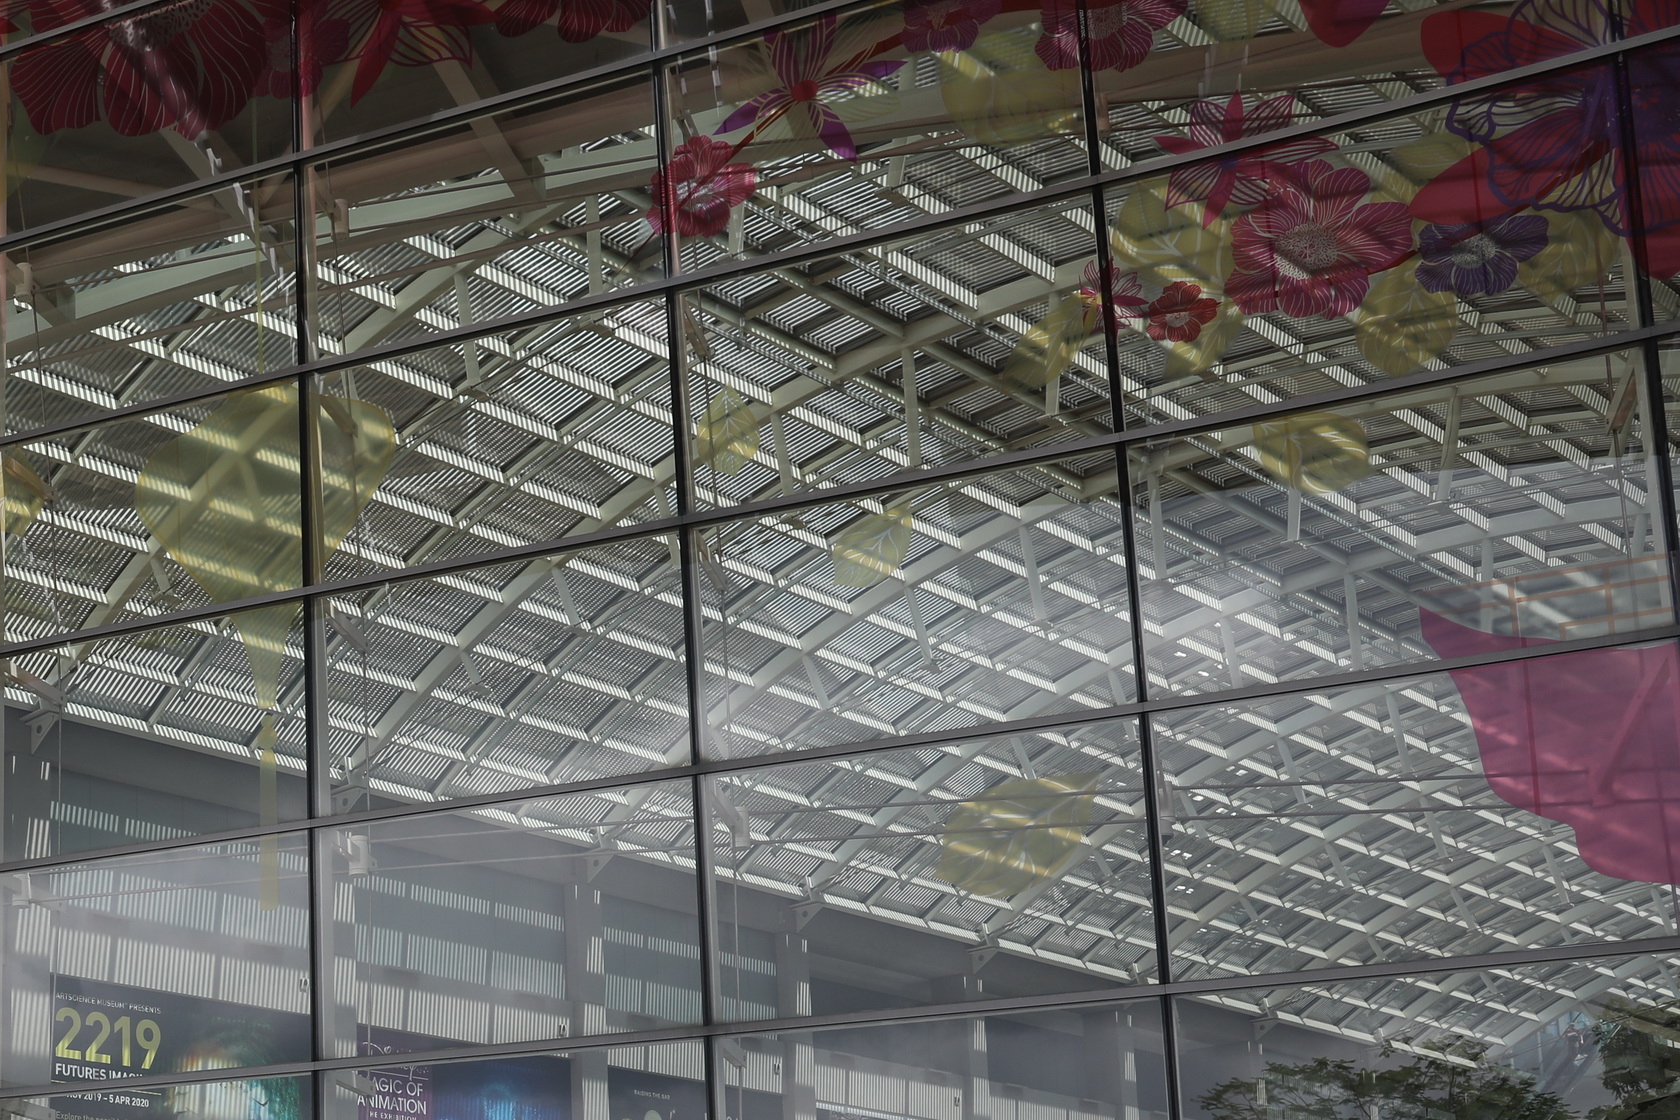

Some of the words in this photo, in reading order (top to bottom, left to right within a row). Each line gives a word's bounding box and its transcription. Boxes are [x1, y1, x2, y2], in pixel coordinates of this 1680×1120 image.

[56, 992, 97, 1005] ARTSCIENCE
[129, 1004, 162, 1015] PRESENTS
[56, 1007, 161, 1069] 2219
[55, 1063, 107, 1080] FUTURES
[373, 1076, 403, 1094] AGIC
[406, 1082, 423, 1097] OF
[109, 1095, 114, 1103] 5
[115, 1096, 131, 1105] APR
[131, 1098, 149, 1107] 2020
[357, 1094, 427, 1115] ANIMATION
